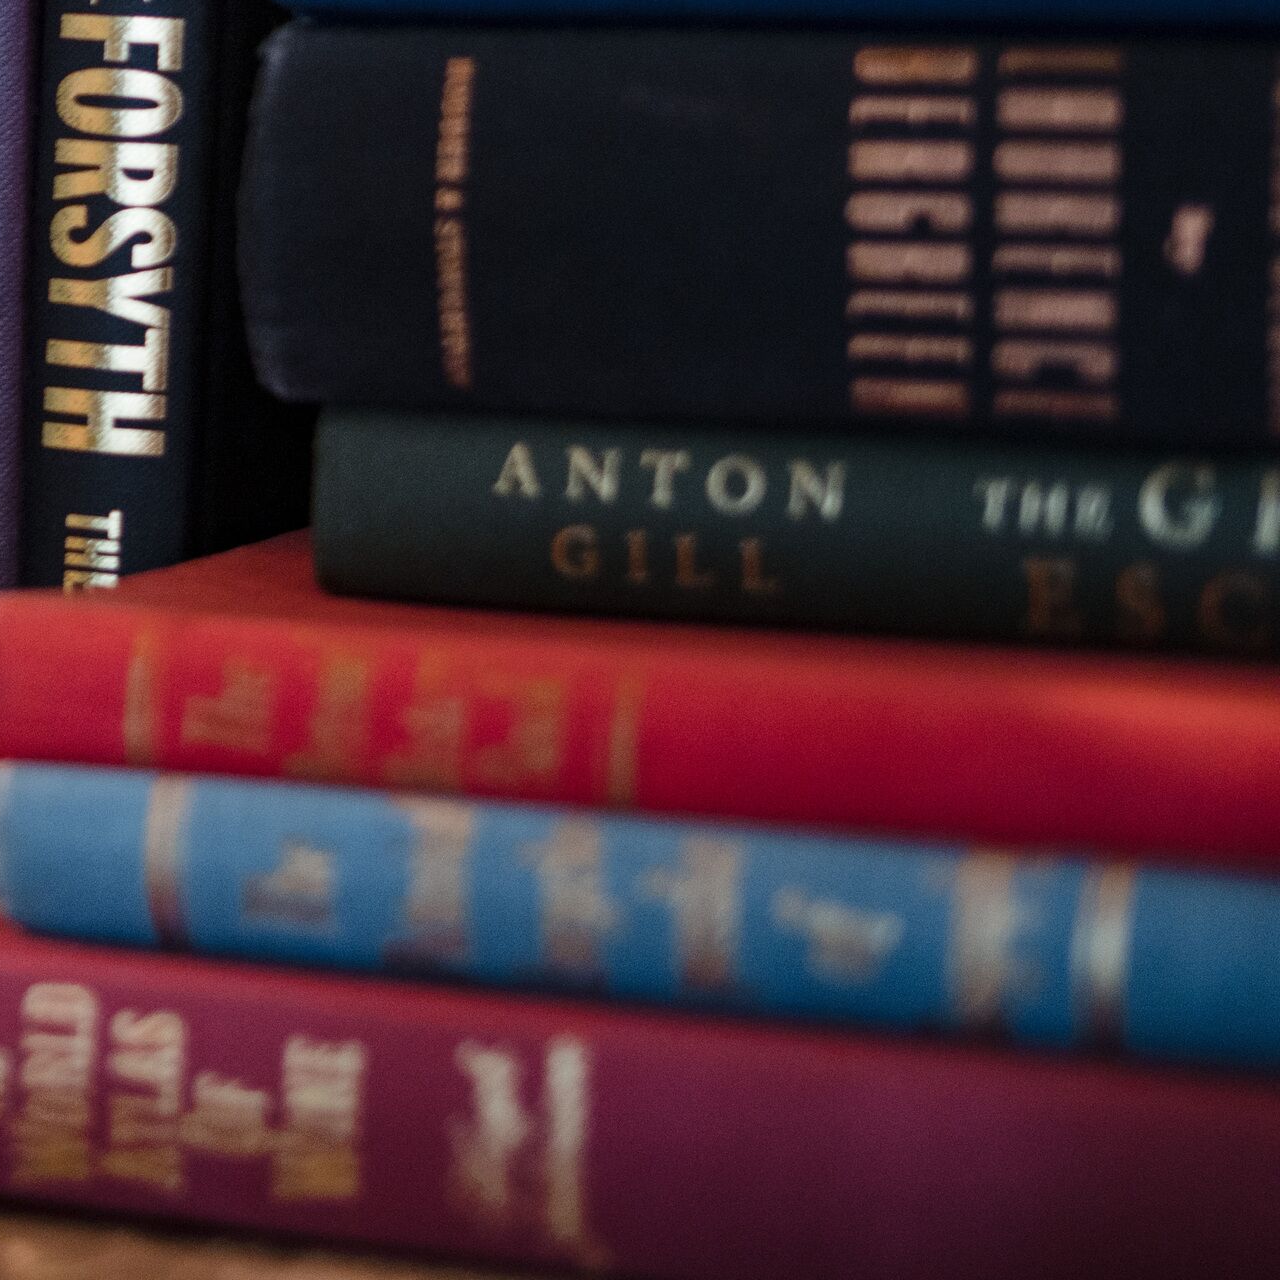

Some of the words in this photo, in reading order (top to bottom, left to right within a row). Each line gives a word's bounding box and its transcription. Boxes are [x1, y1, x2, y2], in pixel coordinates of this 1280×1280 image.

[42, 12, 185, 457] FORSYTH
[492, 441, 848, 519] ANTON
[550, 522, 780, 593] GILL
